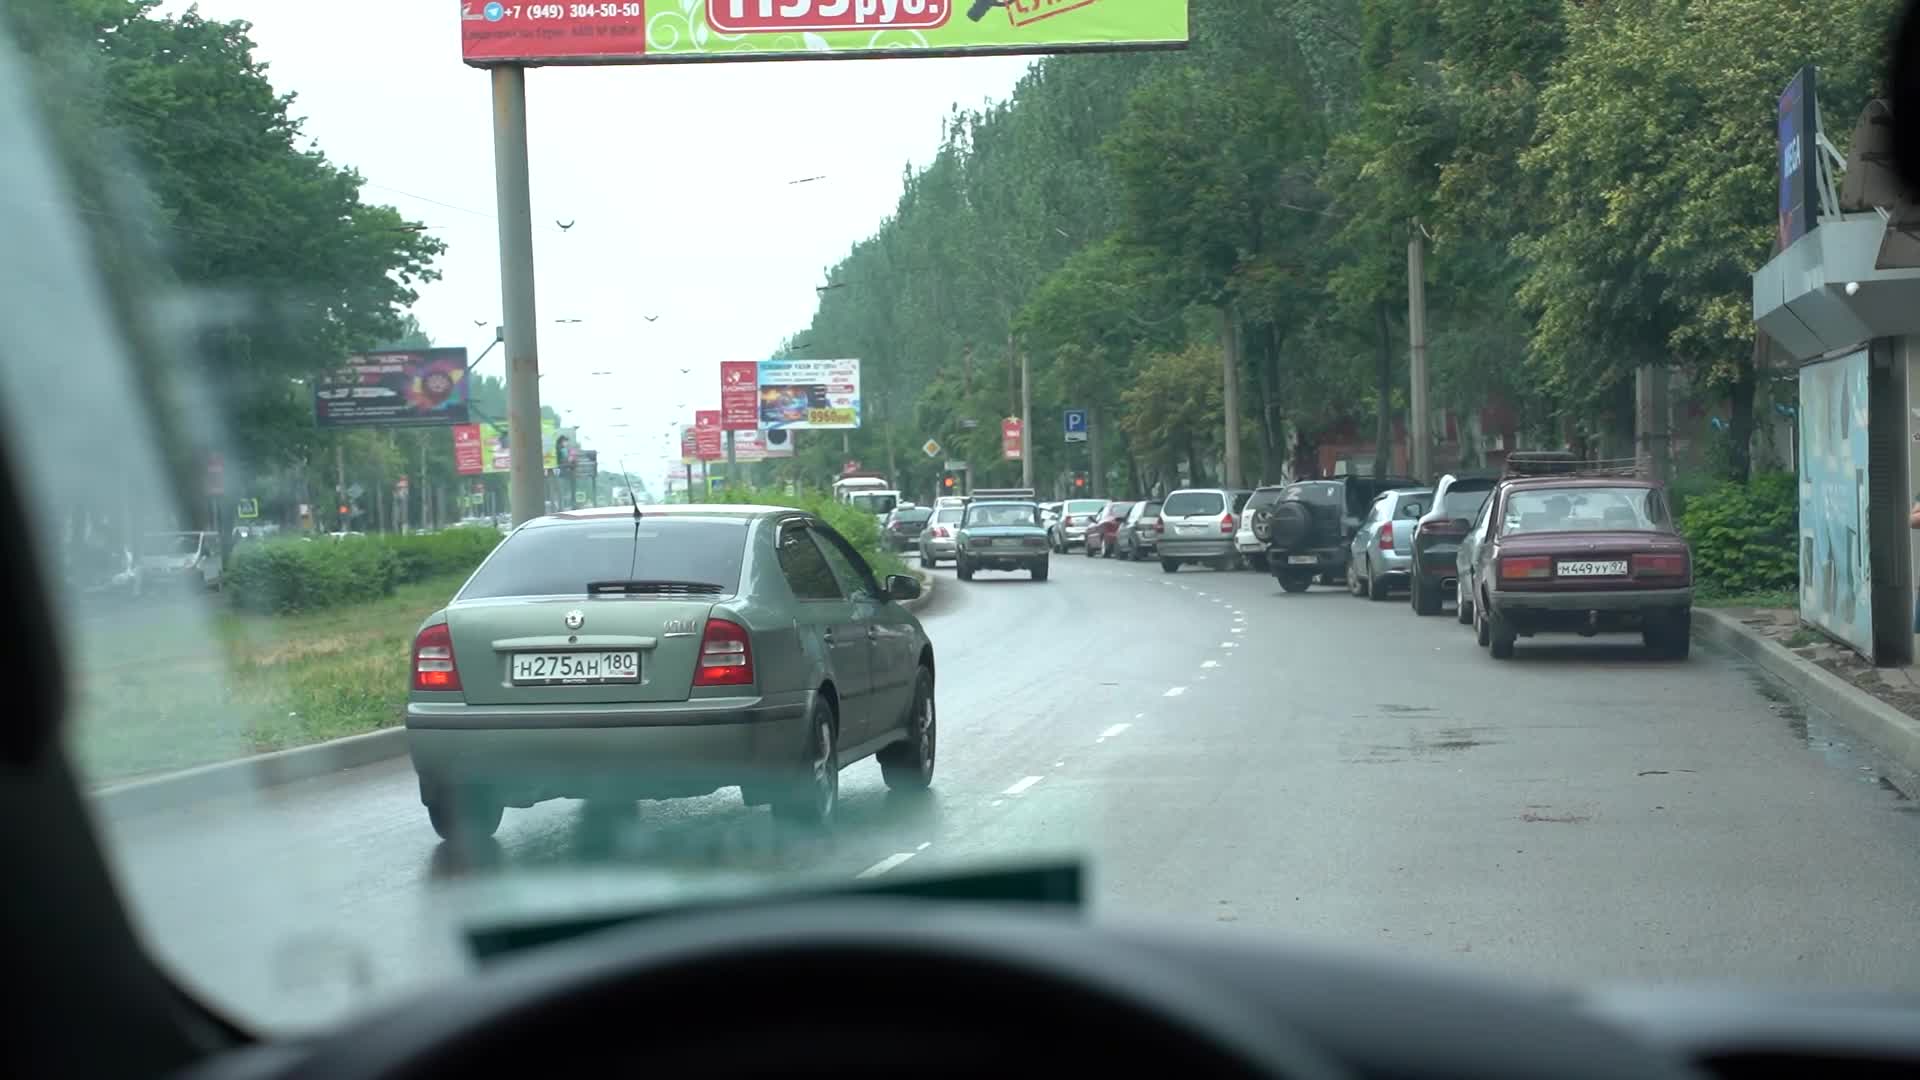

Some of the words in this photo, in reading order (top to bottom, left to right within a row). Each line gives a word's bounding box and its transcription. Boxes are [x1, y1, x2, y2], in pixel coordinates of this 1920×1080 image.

[504, 5, 521, 19] +7
[526, 4, 564, 20] (949)
[569, 3, 641, 18] 304-50-50
[1068, 413, 1081, 430] P
[520, 655, 599, 676] Н275АН
[603, 653, 633, 670] 180
